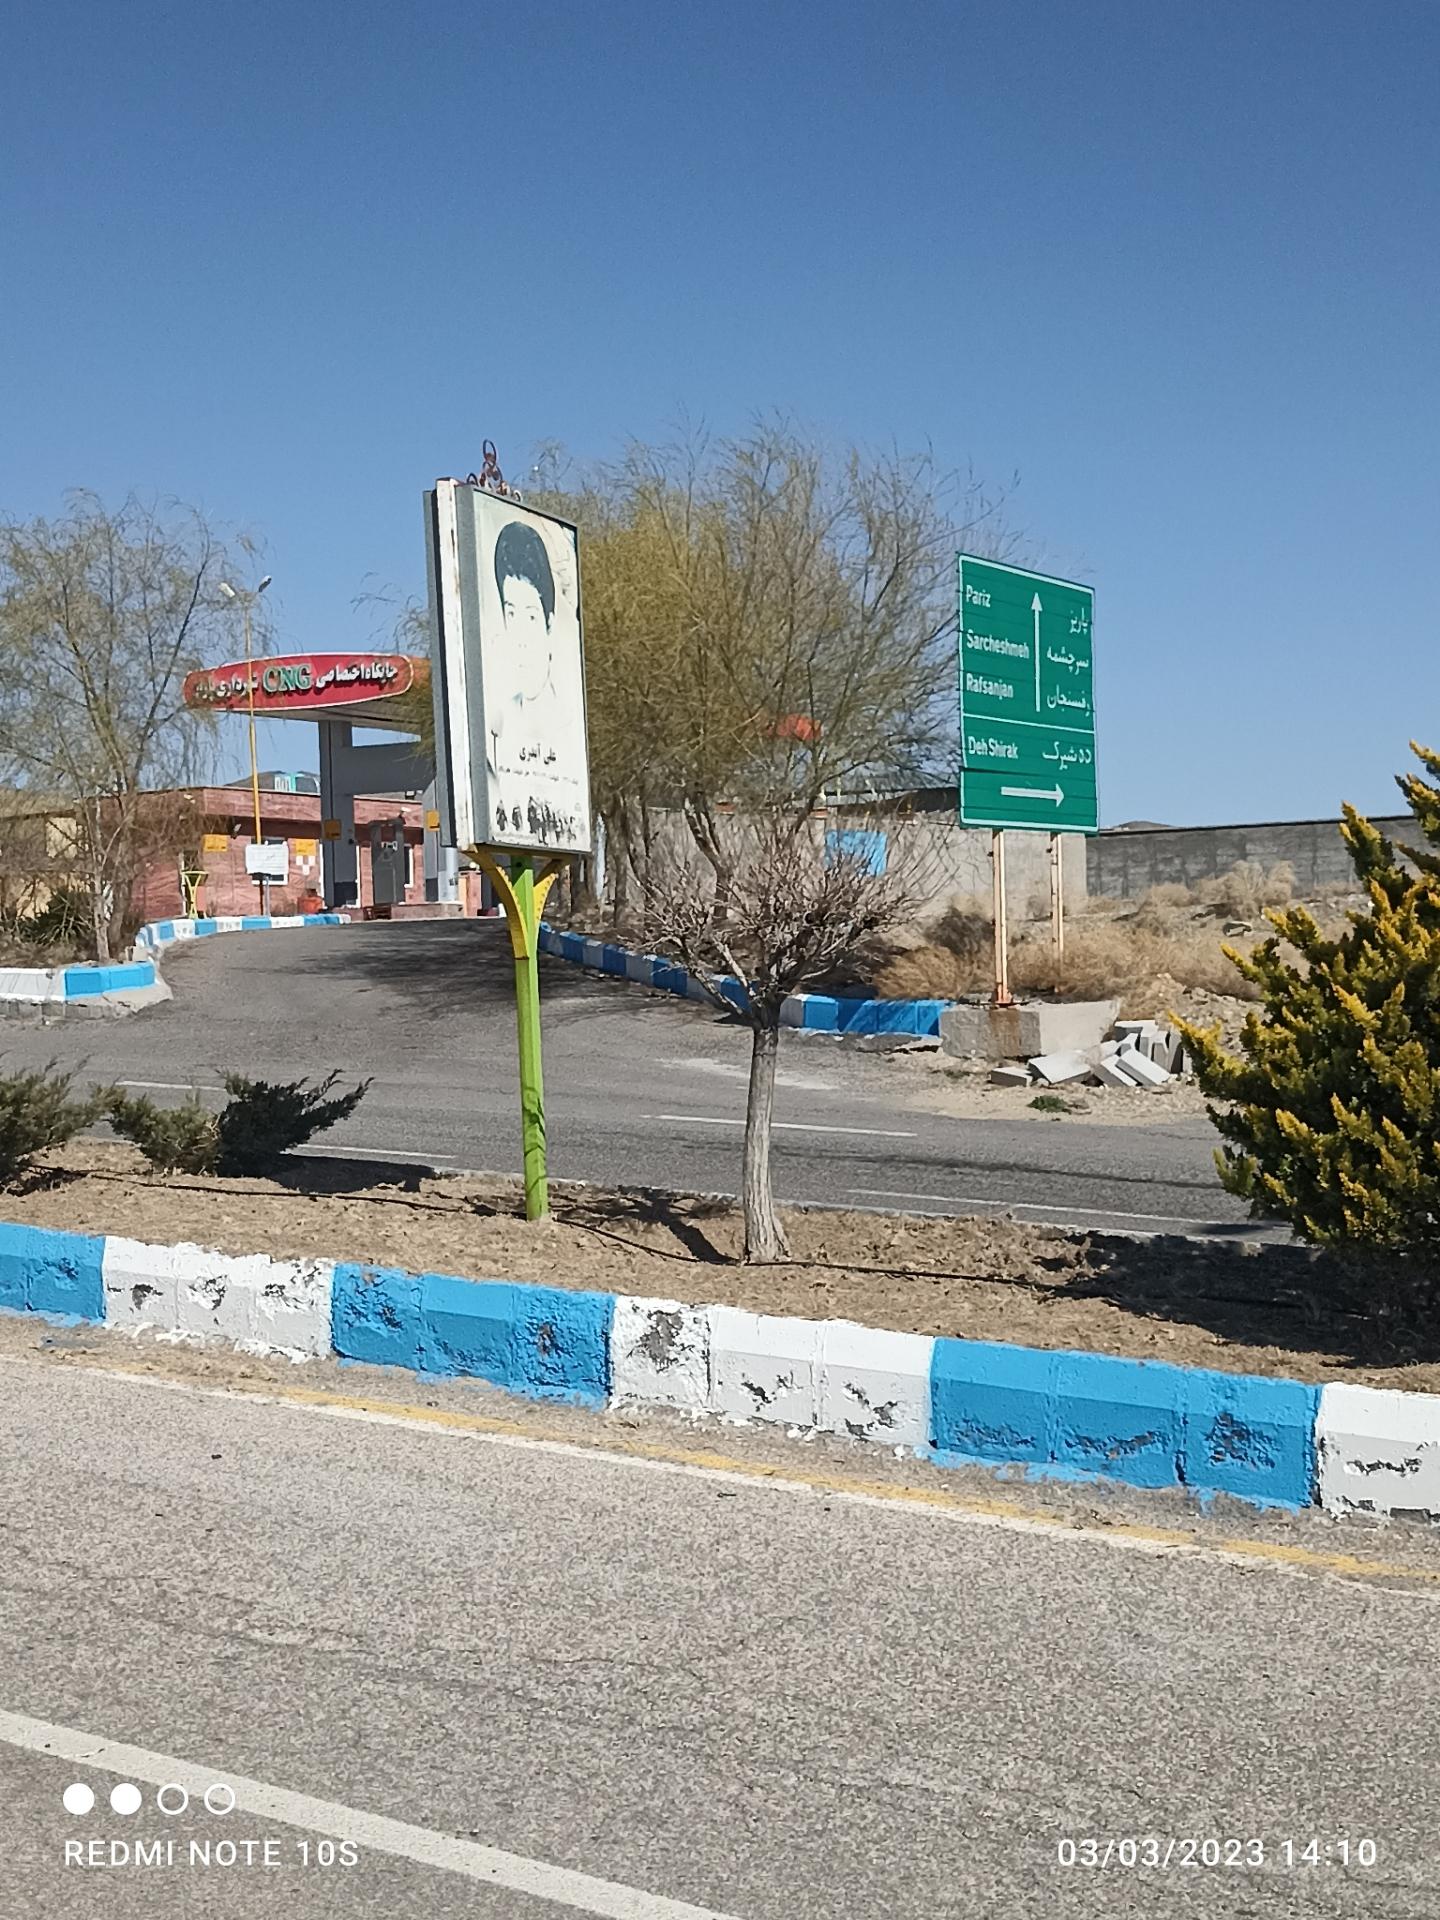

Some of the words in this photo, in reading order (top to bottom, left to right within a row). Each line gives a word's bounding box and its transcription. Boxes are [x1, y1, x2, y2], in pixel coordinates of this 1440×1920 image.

[965, 584, 991, 608] Pariz
[1069, 607, 1089, 635] پاریز
[966, 629, 1030, 659] Sarcheshmeh
[365, 661, 399, 684] جایگاه
[1046, 645, 1089, 675] سرچشمه
[262, 662, 313, 692] CNG
[316, 663, 365, 688] اختصاصی
[966, 673, 1014, 700] Rafsanjan
[1047, 684, 1091, 717] رفسنجان
[967, 735, 988, 756] Deh
[988, 737, 1019, 760] Shirak
[1041, 740, 1078, 771] شیرک
[1078, 748, 1092, 764] ده
